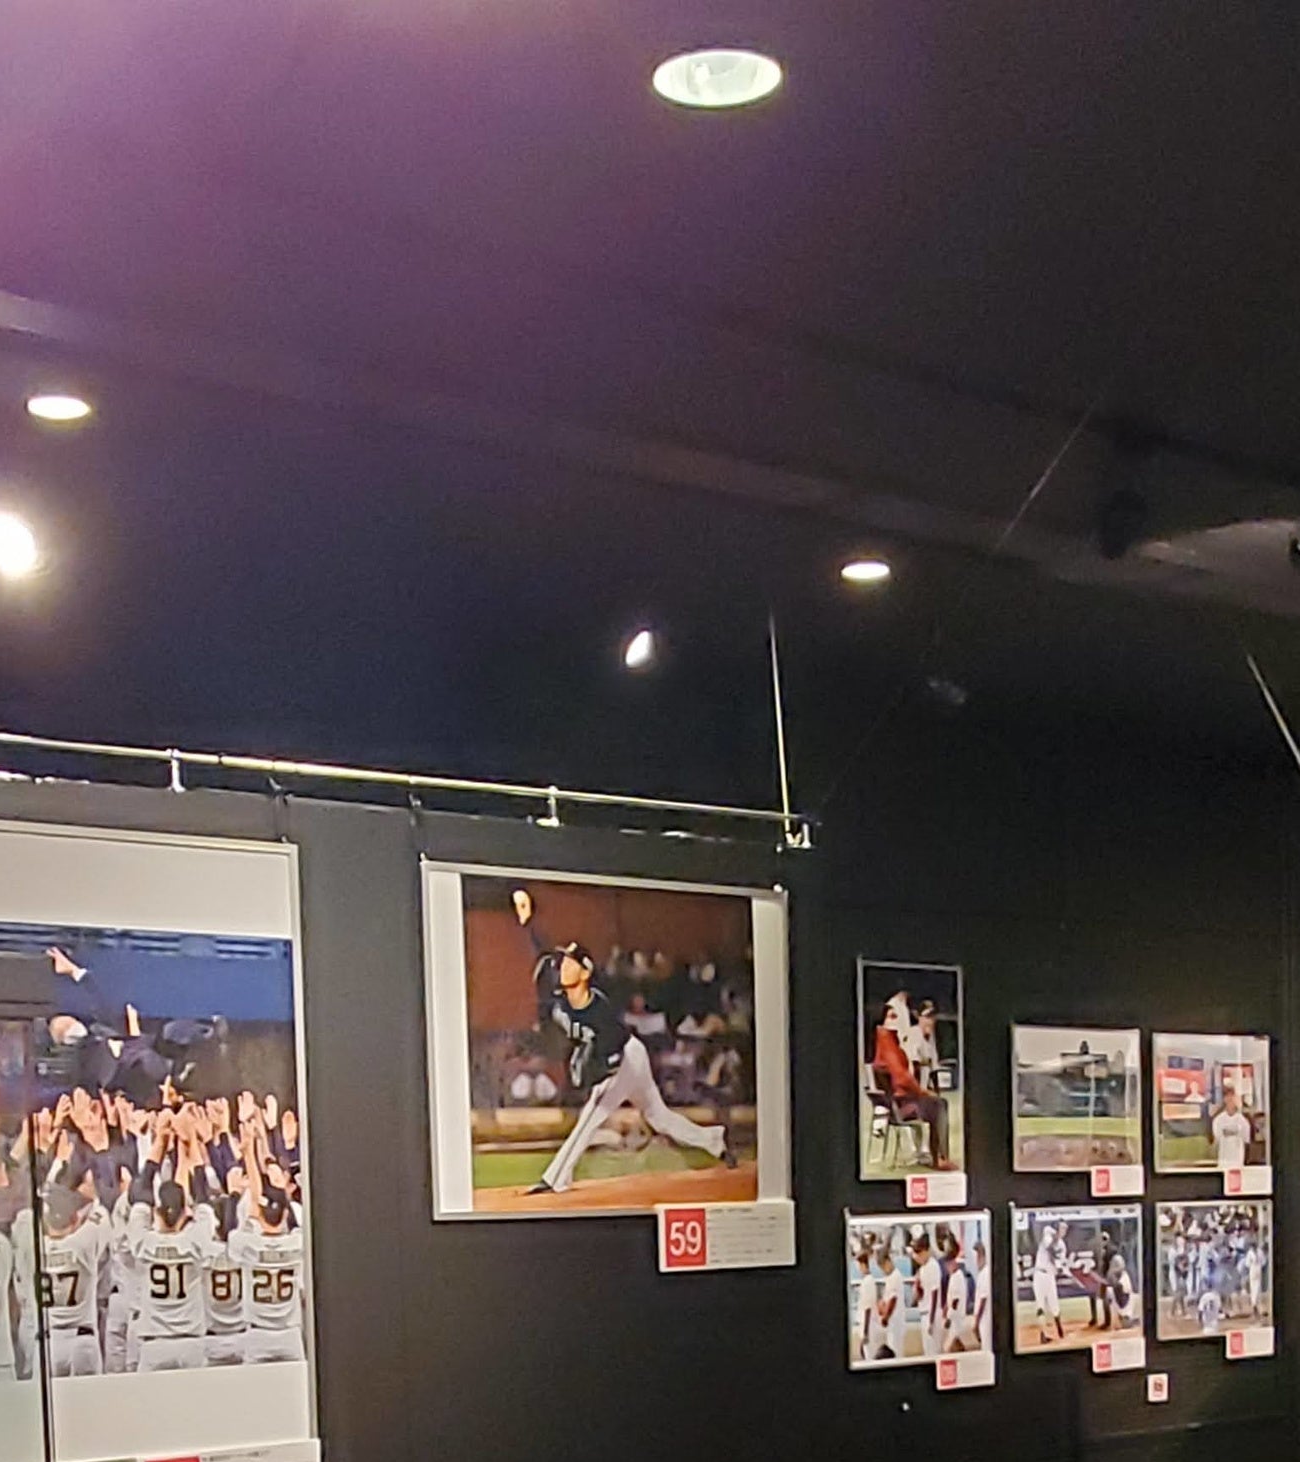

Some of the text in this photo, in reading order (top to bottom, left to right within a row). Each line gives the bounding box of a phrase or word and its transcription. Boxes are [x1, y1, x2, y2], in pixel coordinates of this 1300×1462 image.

[669, 1220, 703, 1257] 59
[149, 1262, 188, 1301] 91
[251, 1268, 296, 1304] 26
